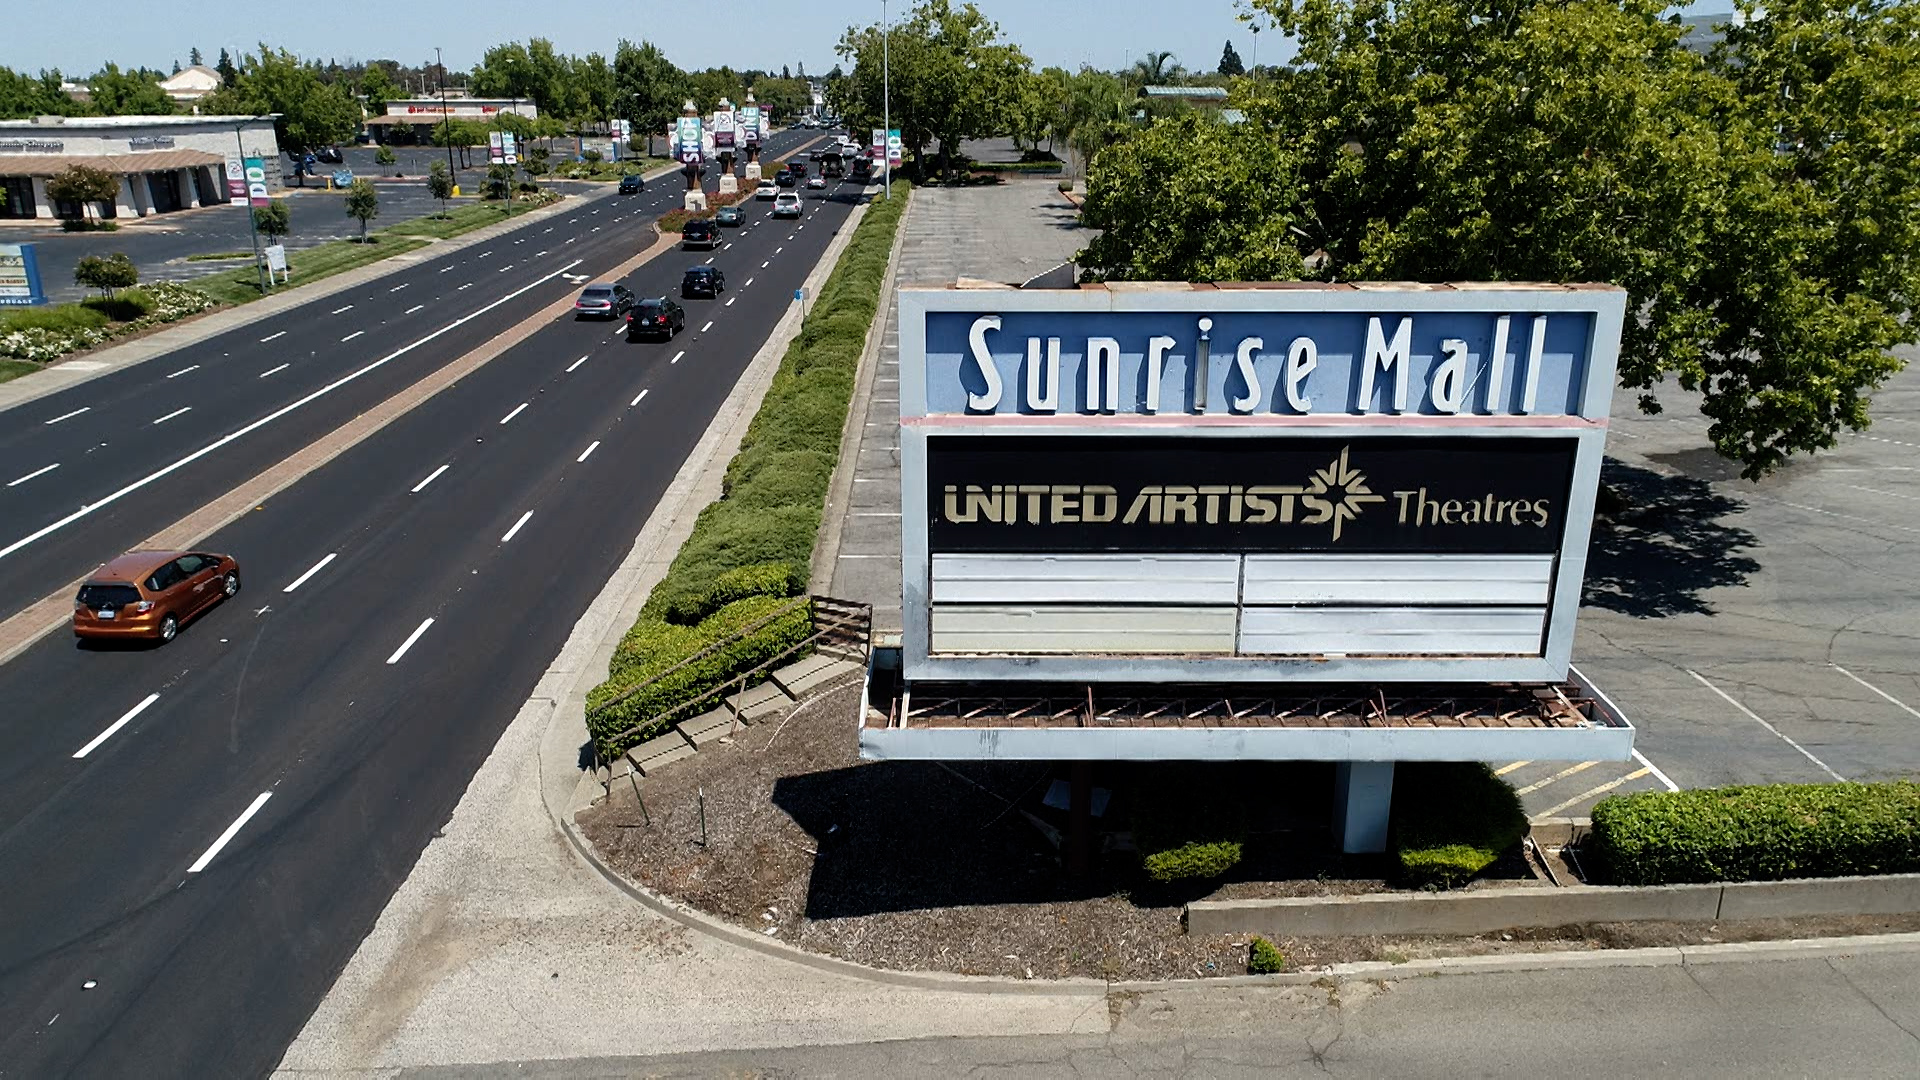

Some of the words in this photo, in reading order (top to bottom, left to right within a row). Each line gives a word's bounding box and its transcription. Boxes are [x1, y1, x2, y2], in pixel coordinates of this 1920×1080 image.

[968, 315, 1317, 412] Sunrise
[1357, 315, 1547, 413] Mall
[944, 485, 1118, 525] UNITED
[1122, 485, 1334, 525] ARTISTS
[1393, 487, 1550, 528] Theatres
